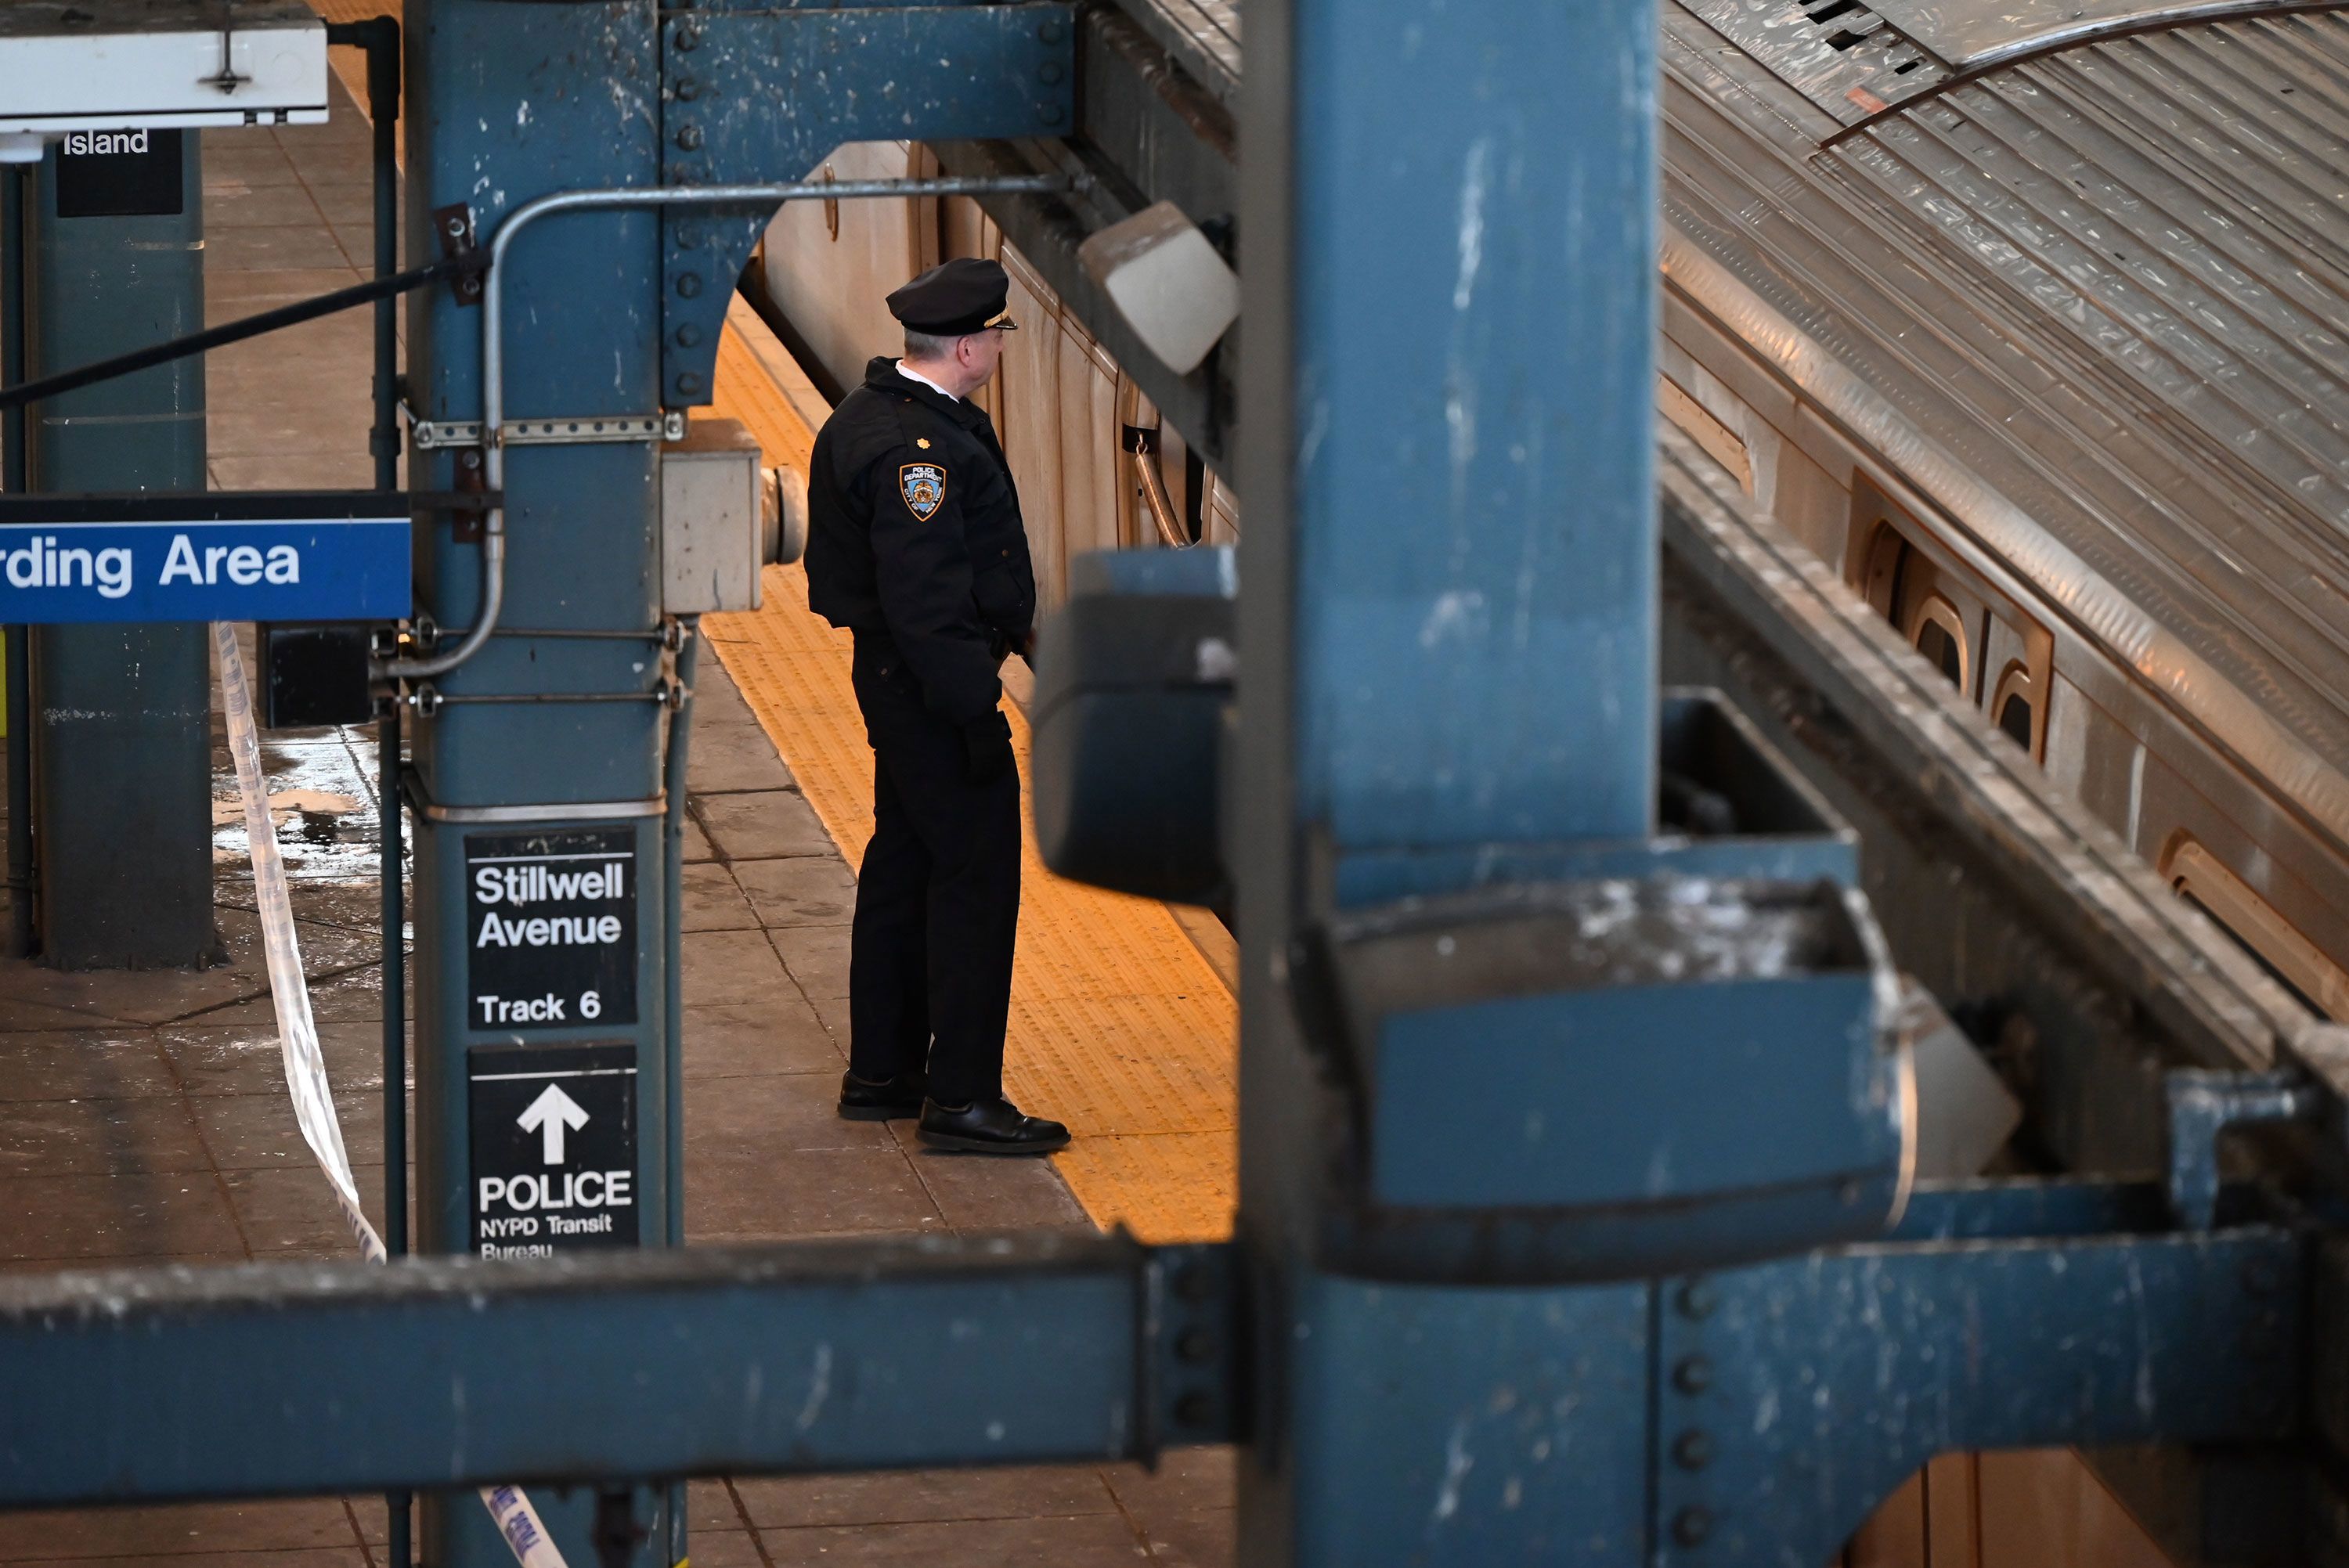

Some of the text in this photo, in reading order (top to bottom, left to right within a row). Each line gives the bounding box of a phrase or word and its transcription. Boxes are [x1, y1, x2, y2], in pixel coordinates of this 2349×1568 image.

[64, 128, 148, 155] Island
[904, 473, 942, 482] DEPARTMENT
[904, 488, 913, 502] CITY
[926, 502, 936, 514] NEW
[159, 534, 300, 586] Area
[475, 863, 623, 904] Stillwell
[477, 911, 622, 948] Avenue
[477, 991, 601, 1022] Track 6
[479, 1170, 632, 1213] POLICE
[480, 1213, 612, 1238] NYPD Transit
[481, 1242, 553, 1261] Bureau
